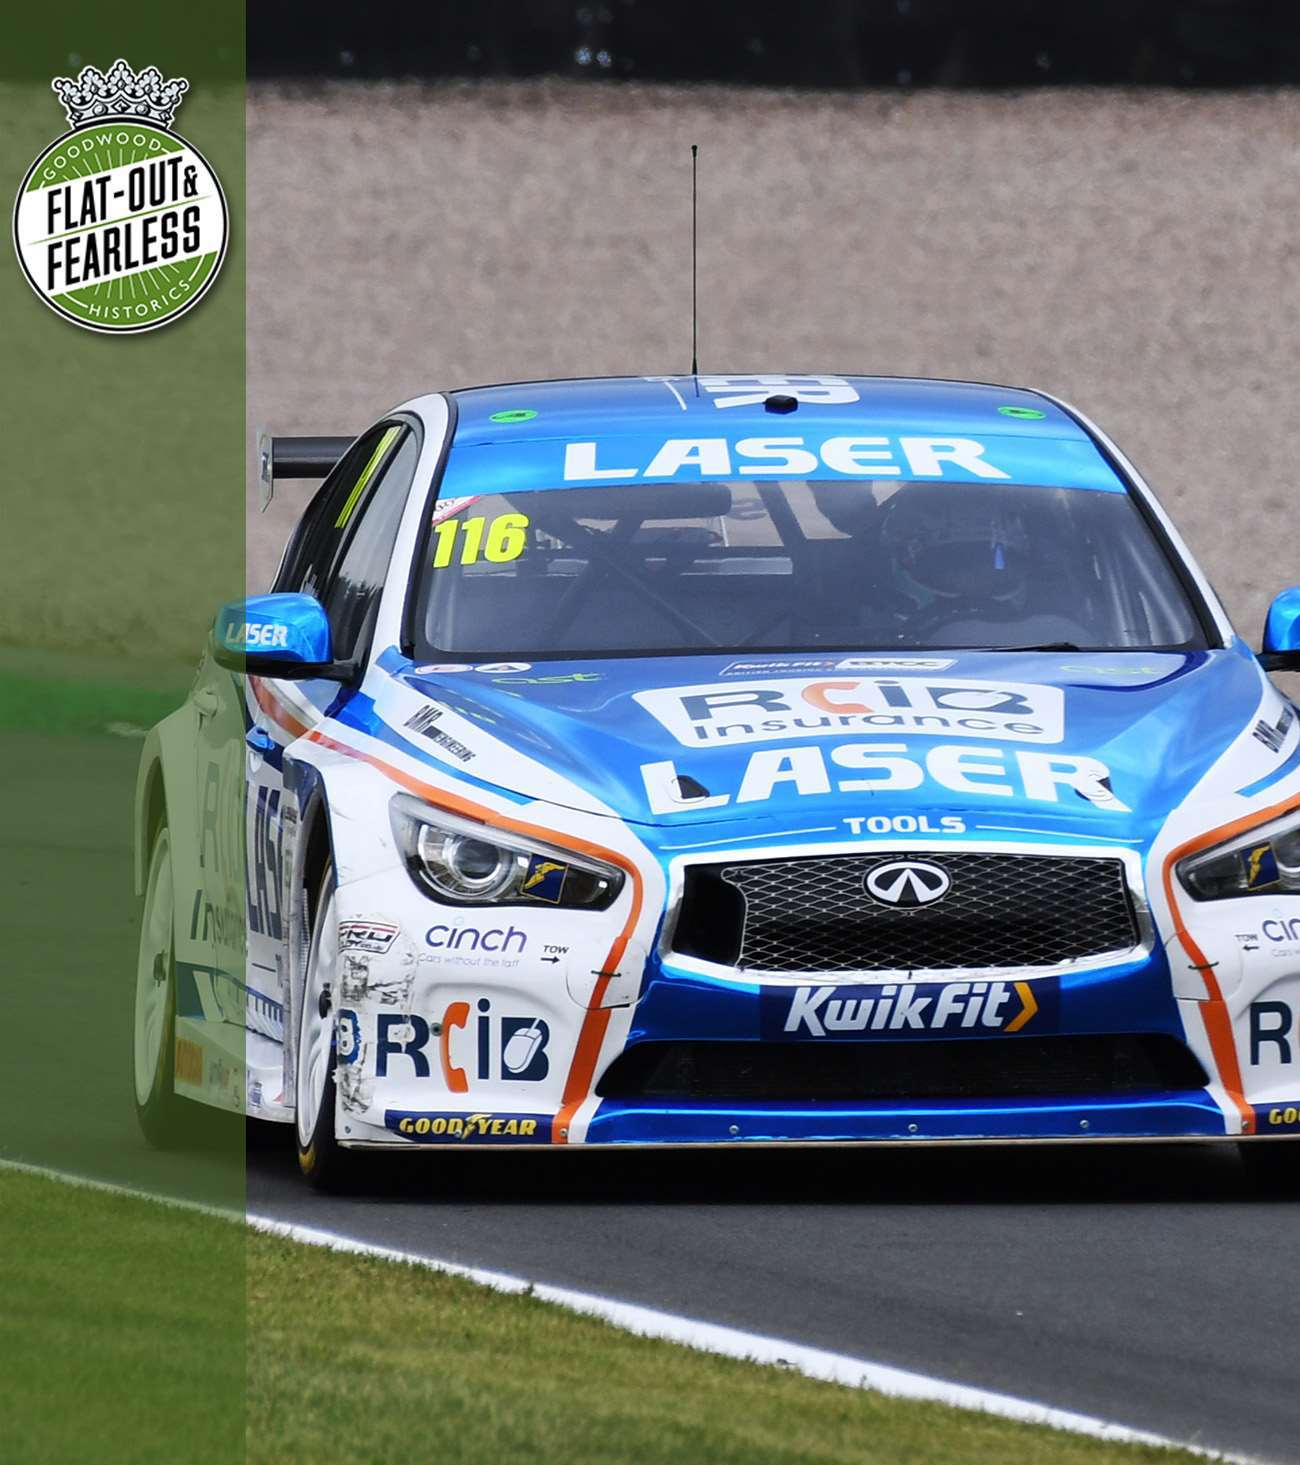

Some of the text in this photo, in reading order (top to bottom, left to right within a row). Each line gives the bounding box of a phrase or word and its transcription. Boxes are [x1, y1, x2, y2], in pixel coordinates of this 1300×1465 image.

[563, 436, 1012, 481] LASER
[432, 513, 529, 569] 116
[225, 622, 289, 648] LASER
[695, 713, 1044, 739] Insurance
[640, 744, 1132, 815] LASER
[843, 815, 966, 834] TOOLS
[425, 924, 528, 953] cinch
[543, 945, 570, 954] TOW
[1234, 934, 1258, 942] TOW
[399, 1115, 537, 1138] GOODYEAR
